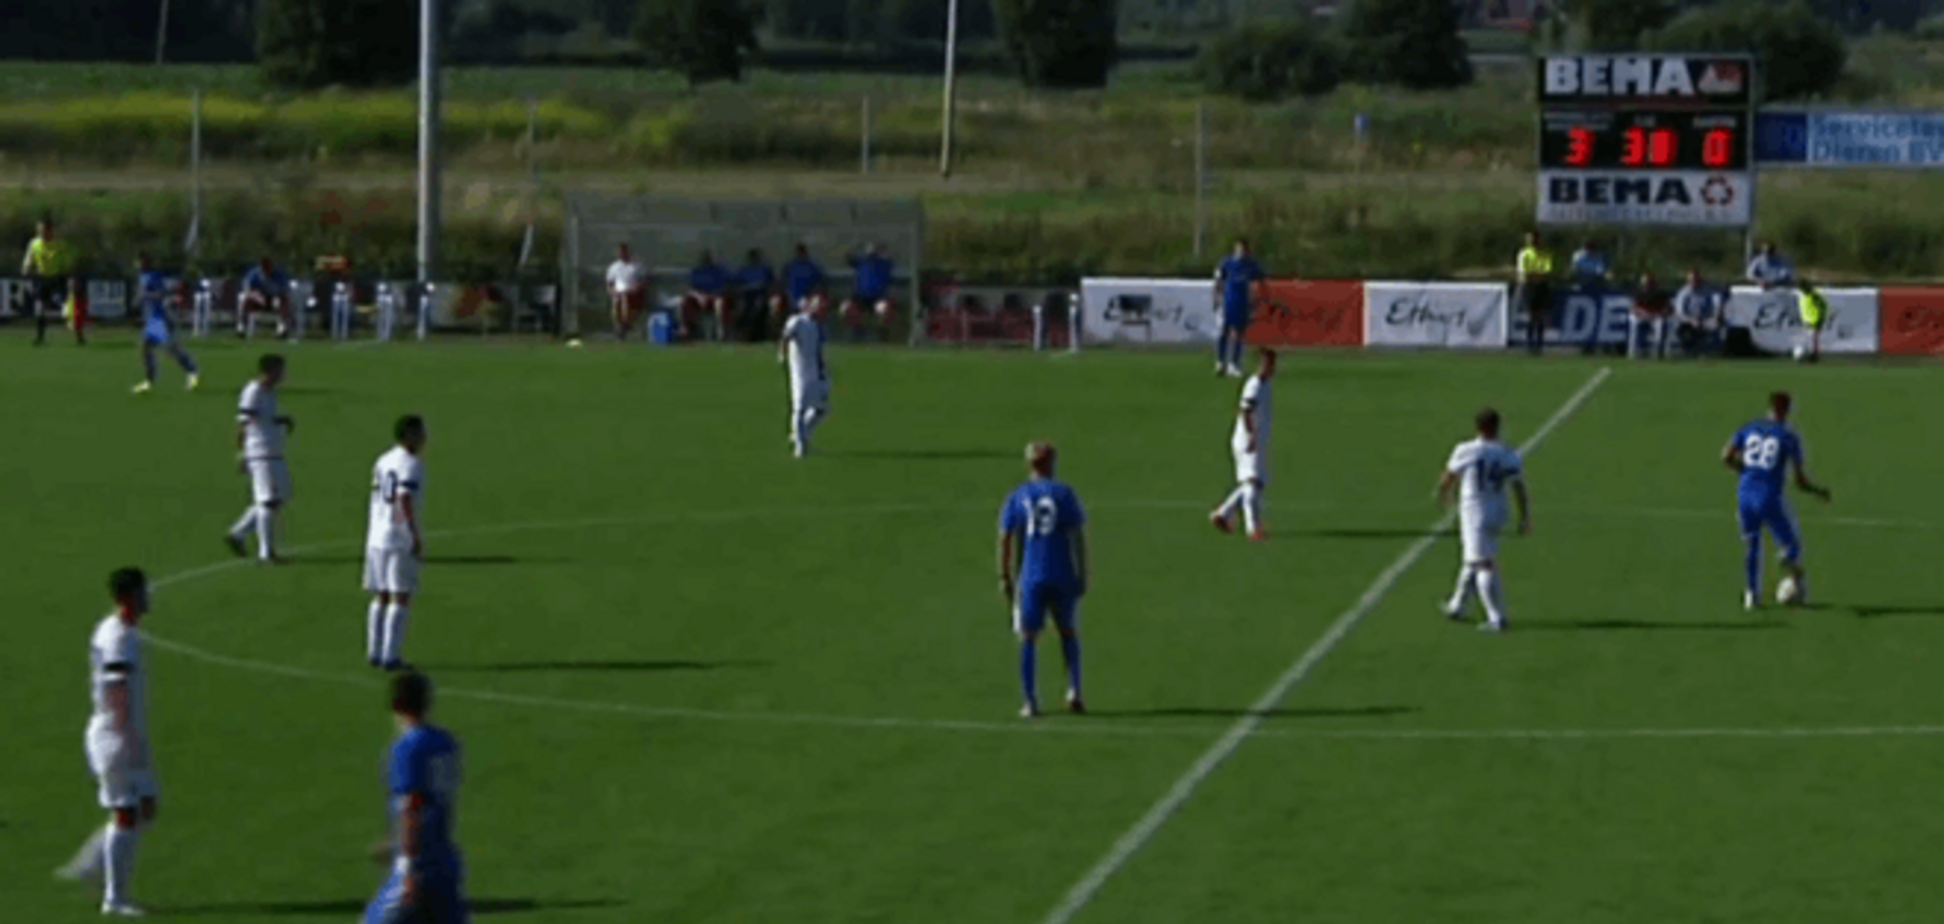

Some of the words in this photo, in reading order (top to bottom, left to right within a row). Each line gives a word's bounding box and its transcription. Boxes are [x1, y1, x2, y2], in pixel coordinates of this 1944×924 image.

[1545, 57, 1694, 94] BEMA
[1549, 177, 1692, 205] BEMA
[1743, 432, 1780, 469] 28
